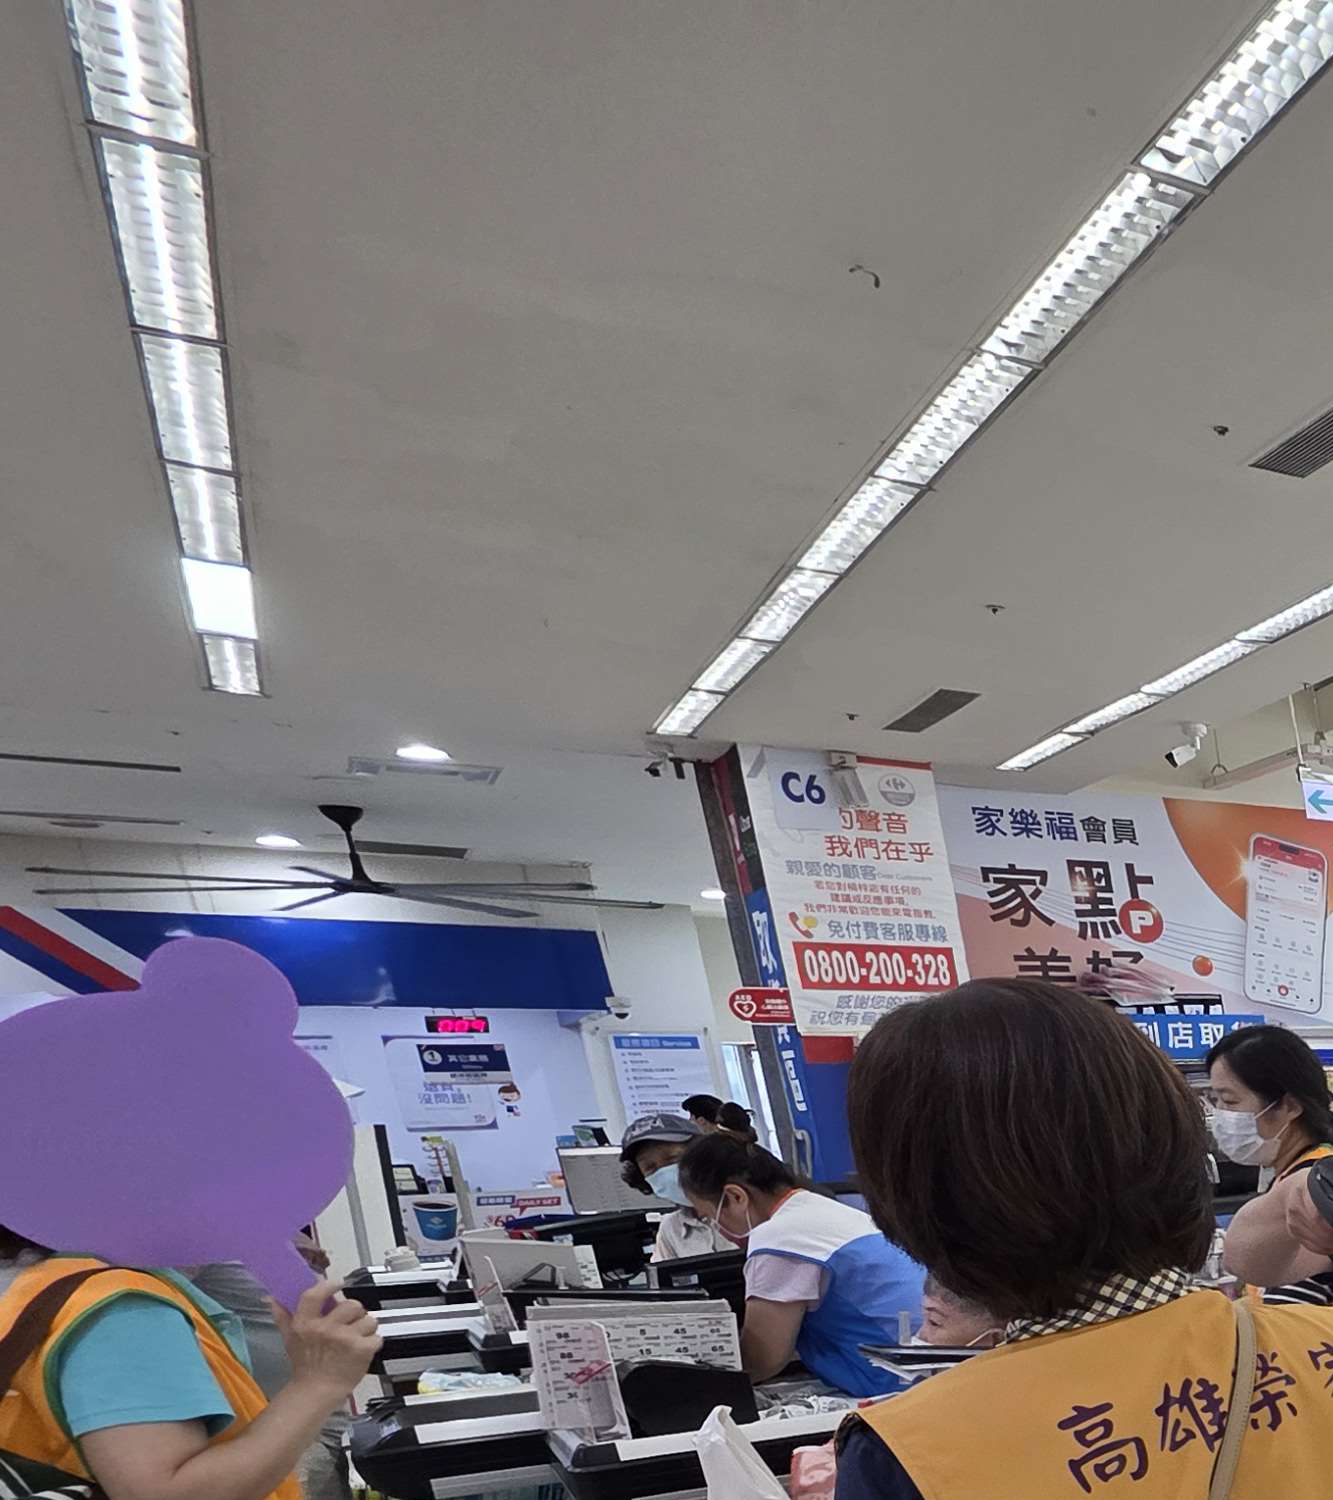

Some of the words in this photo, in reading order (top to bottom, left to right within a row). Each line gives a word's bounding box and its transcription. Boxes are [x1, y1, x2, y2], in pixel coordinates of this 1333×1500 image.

[781, 772, 826, 804] C6
[971, 805, 1139, 846] 家樂福會員
[824, 835, 934, 863] 我們在乎
[785, 860, 877, 880] 親愛的顧客
[827, 920, 949, 943] 免付費客服專線
[804, 949, 951, 986] 0800-200-328
